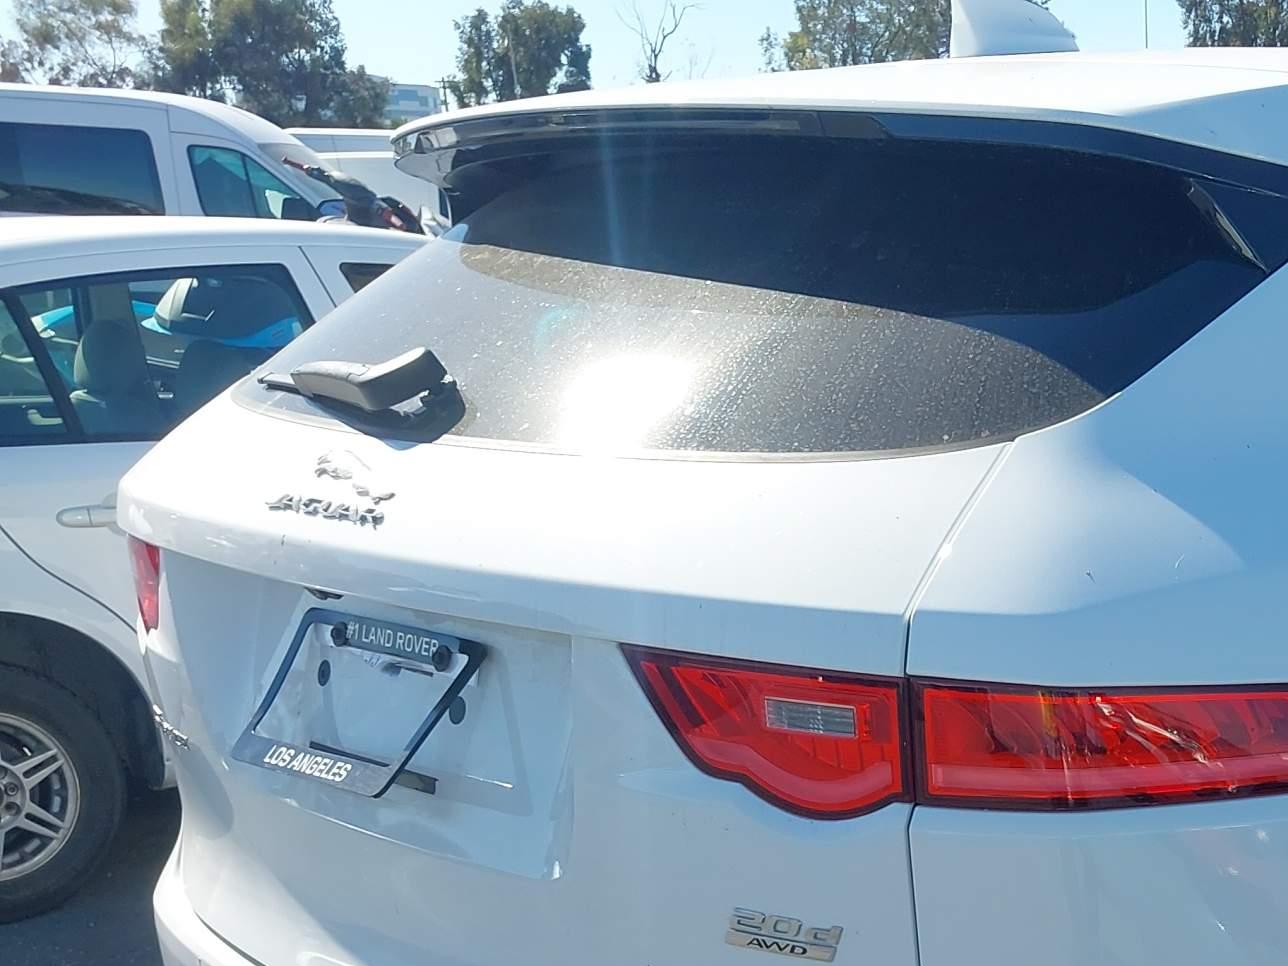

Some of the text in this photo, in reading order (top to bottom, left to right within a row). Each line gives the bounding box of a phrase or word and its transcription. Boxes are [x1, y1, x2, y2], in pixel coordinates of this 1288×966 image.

[362, 624, 394, 648] LAND
[264, 745, 352, 782] LOS ANGELES
[729, 906, 844, 946] 20d
[746, 937, 808, 956] AWD
